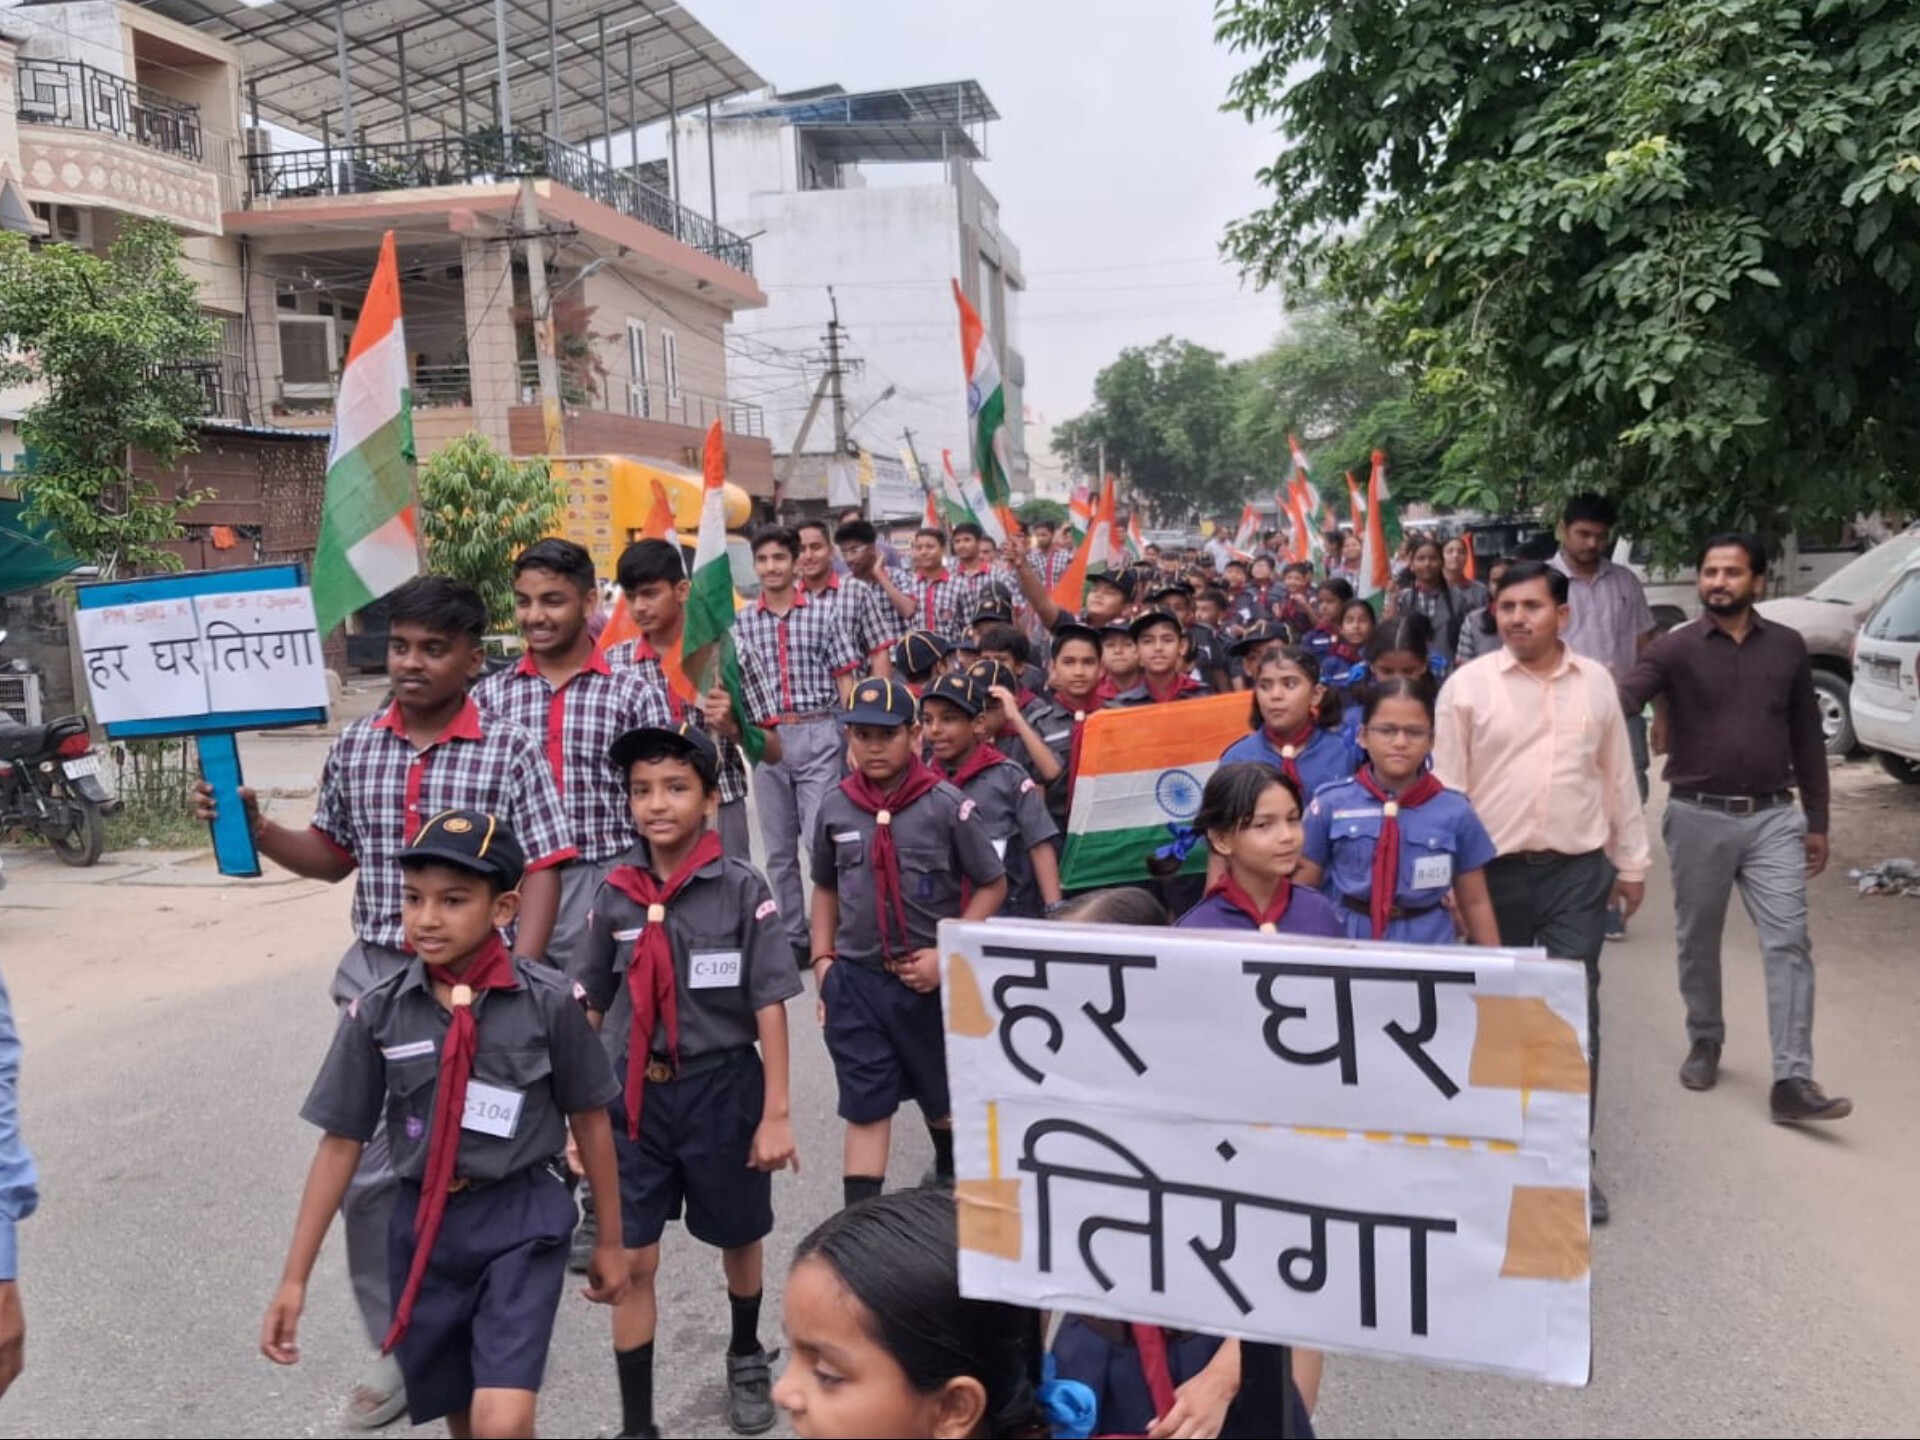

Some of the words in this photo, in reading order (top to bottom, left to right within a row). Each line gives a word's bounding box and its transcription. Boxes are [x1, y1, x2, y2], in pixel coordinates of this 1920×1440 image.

[84, 645, 130, 690] हर
[149, 637, 200, 675] घर
[206, 617, 316, 672] तिरंगा
[694, 961, 738, 976] C-109
[981, 945, 1157, 1084] हर
[1242, 960, 1476, 1099] घर
[464, 1101, 511, 1121] -104
[1017, 1117, 1457, 1337] तिरंगा
